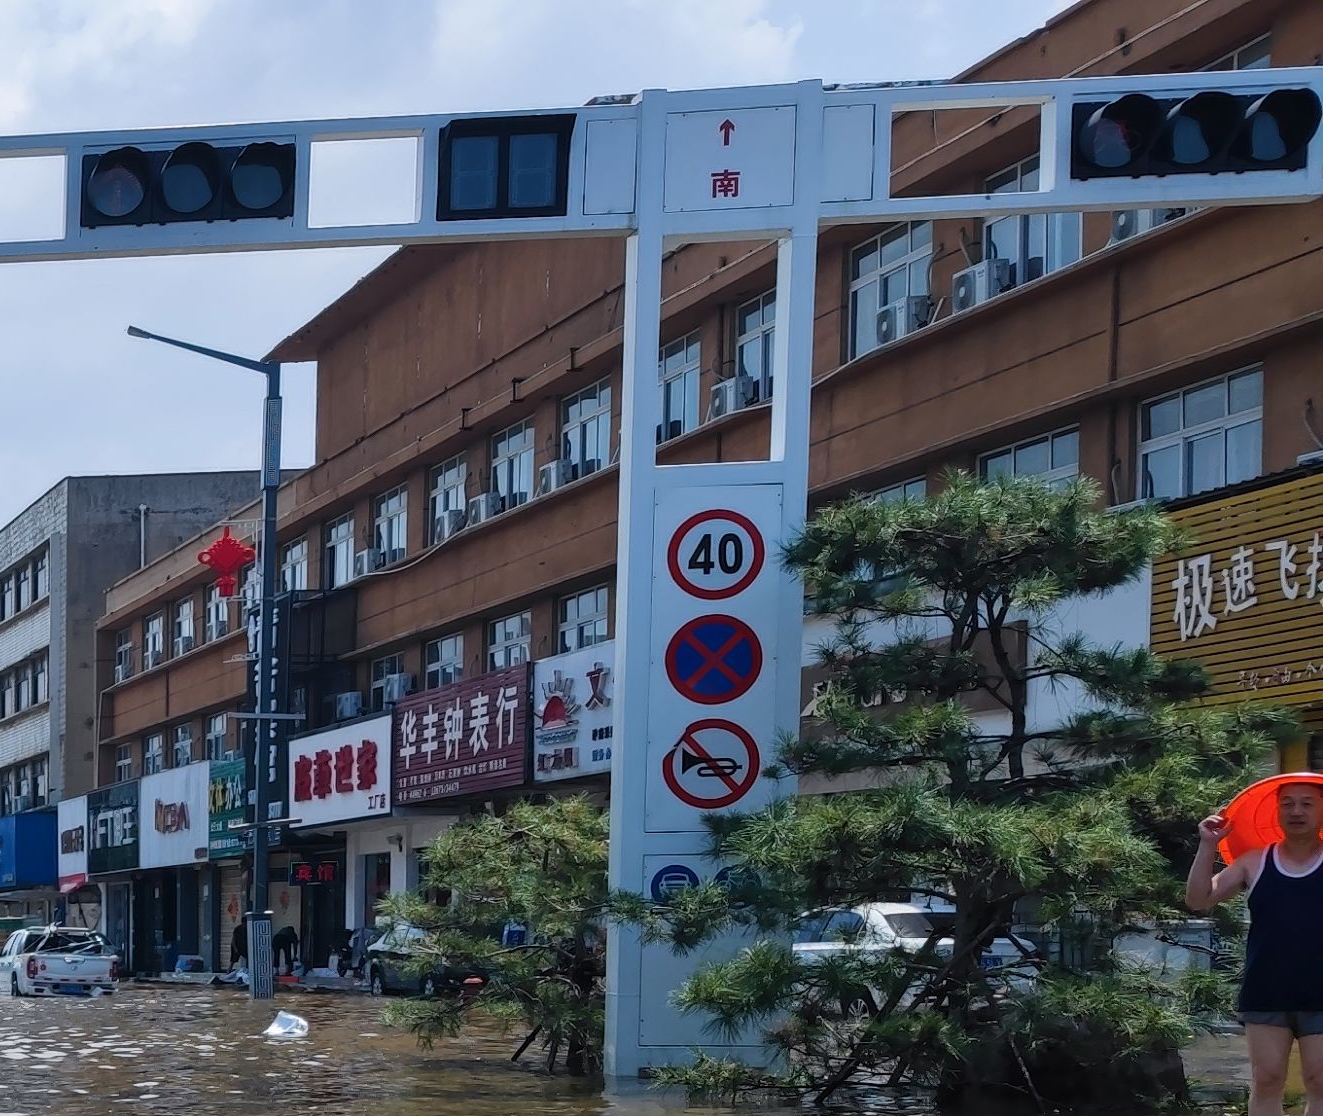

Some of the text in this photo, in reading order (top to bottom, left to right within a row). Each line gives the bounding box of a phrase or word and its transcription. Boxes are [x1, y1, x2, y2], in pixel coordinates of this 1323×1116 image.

[711, 169, 740, 198] 南
[688, 533, 744, 576] 40
[399, 686, 519, 769] 华丰钟表行
[368, 793, 386, 810] 工厂店
[295, 864, 334, 881] 宾馆
